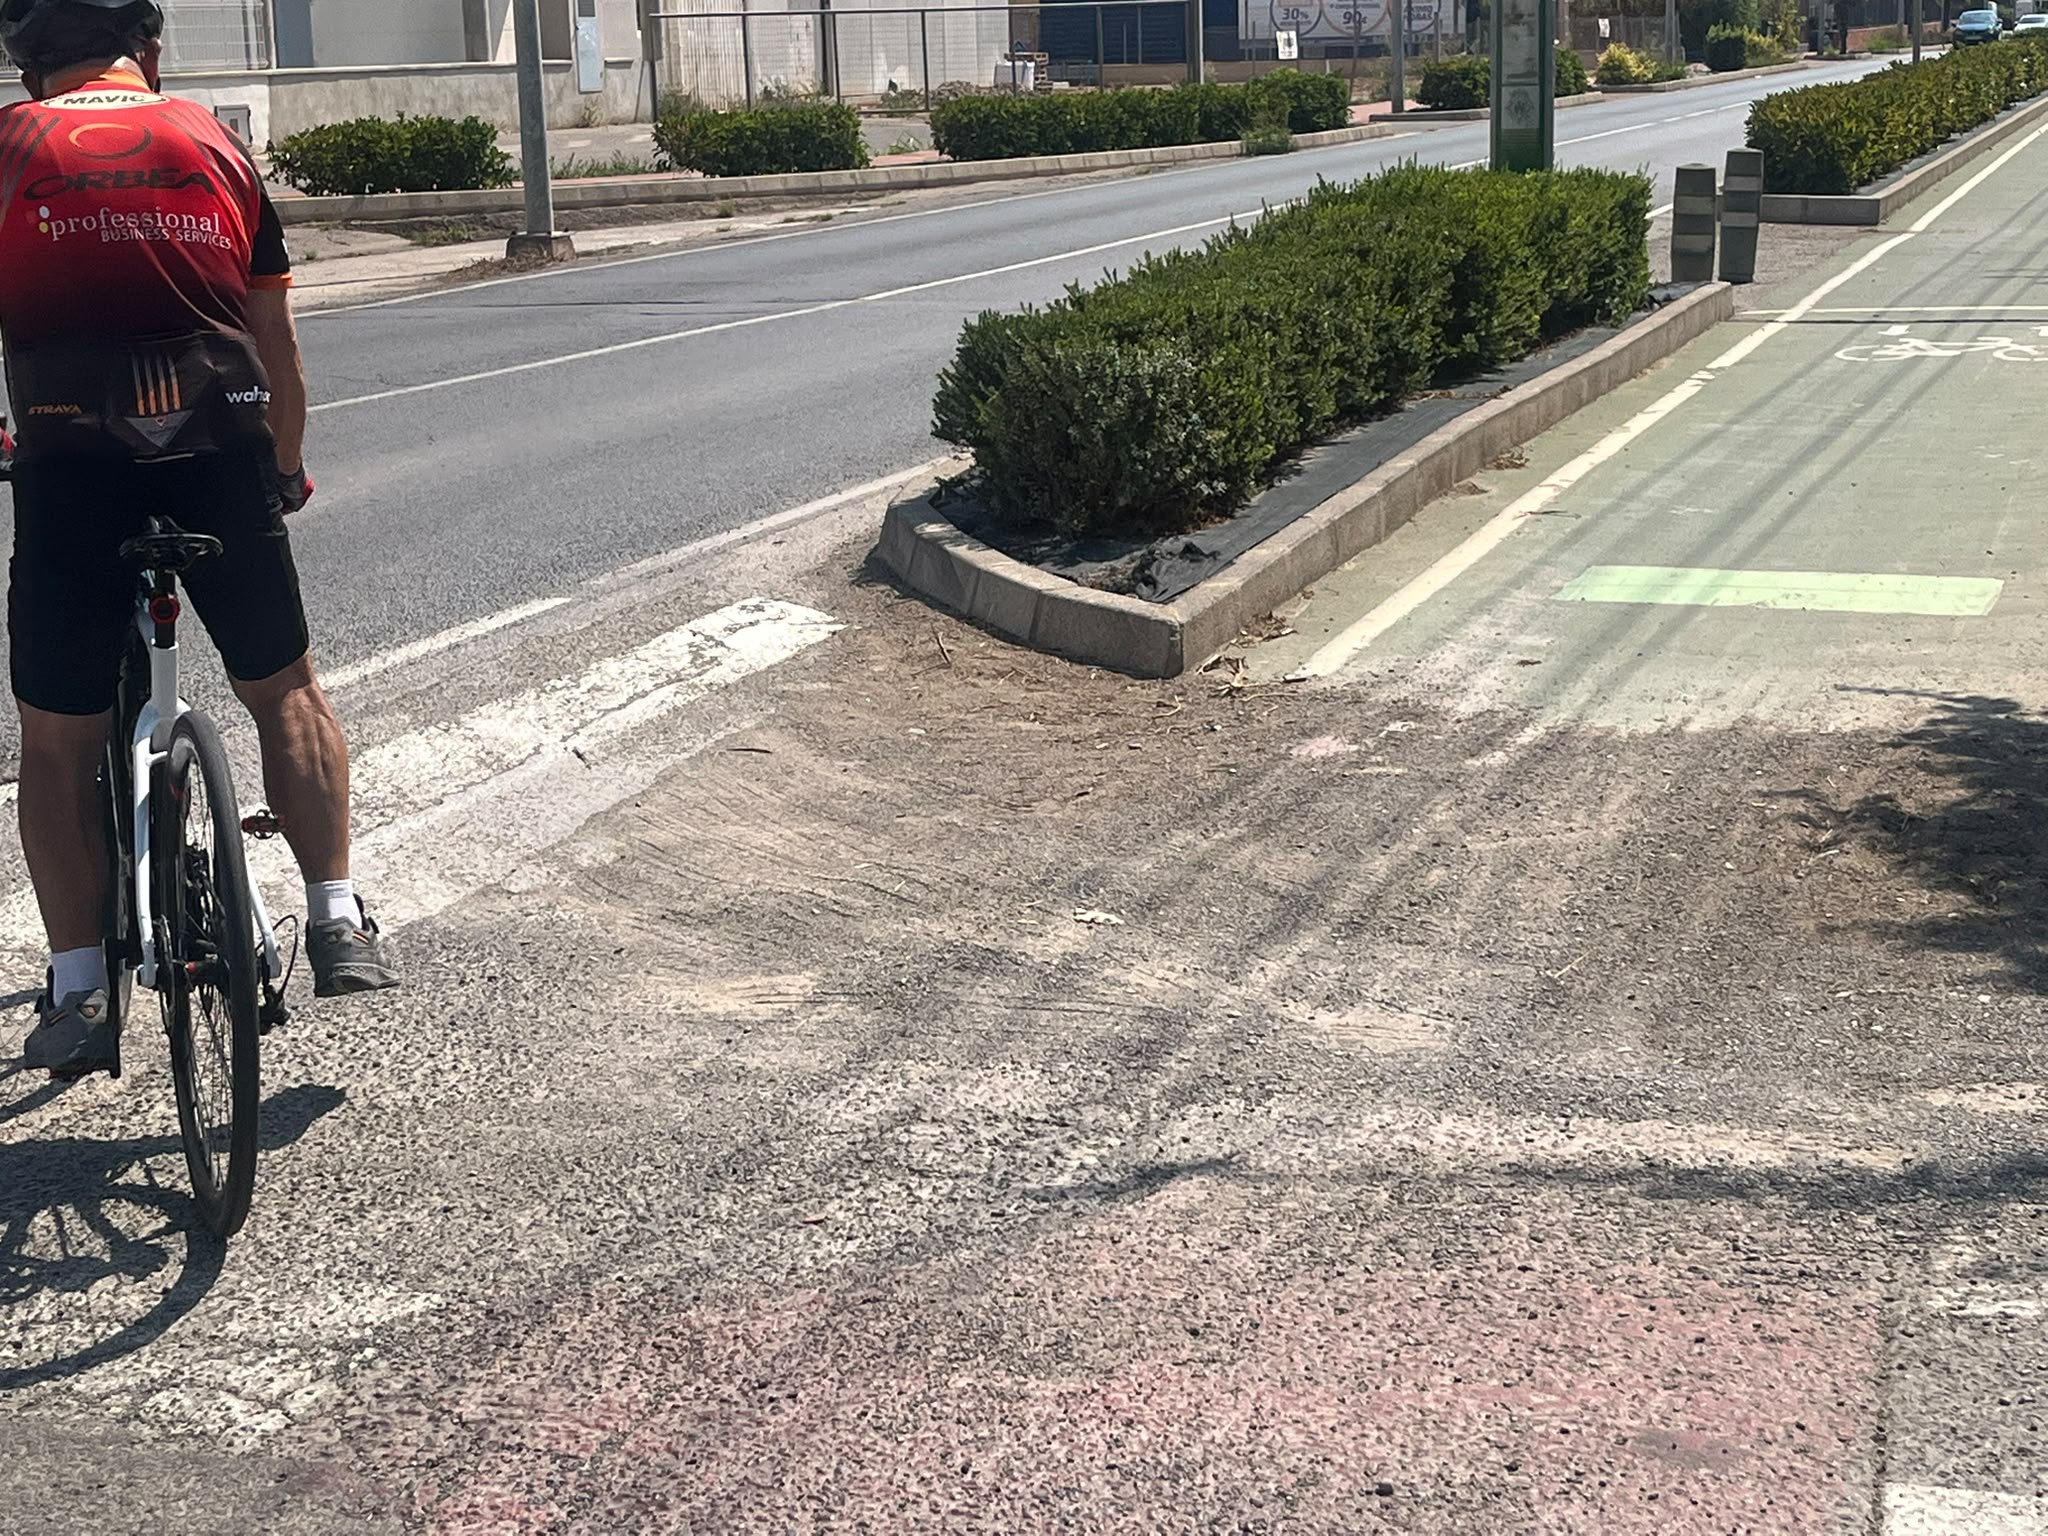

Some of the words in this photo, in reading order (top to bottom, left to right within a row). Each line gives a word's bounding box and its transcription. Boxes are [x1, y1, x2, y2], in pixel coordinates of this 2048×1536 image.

[63, 95, 145, 105] MAVIC
[24, 168, 216, 199] ORBEA
[51, 207, 220, 241] professional
[101, 228, 170, 242] BUSINESS
[176, 229, 231, 249] SERVICES
